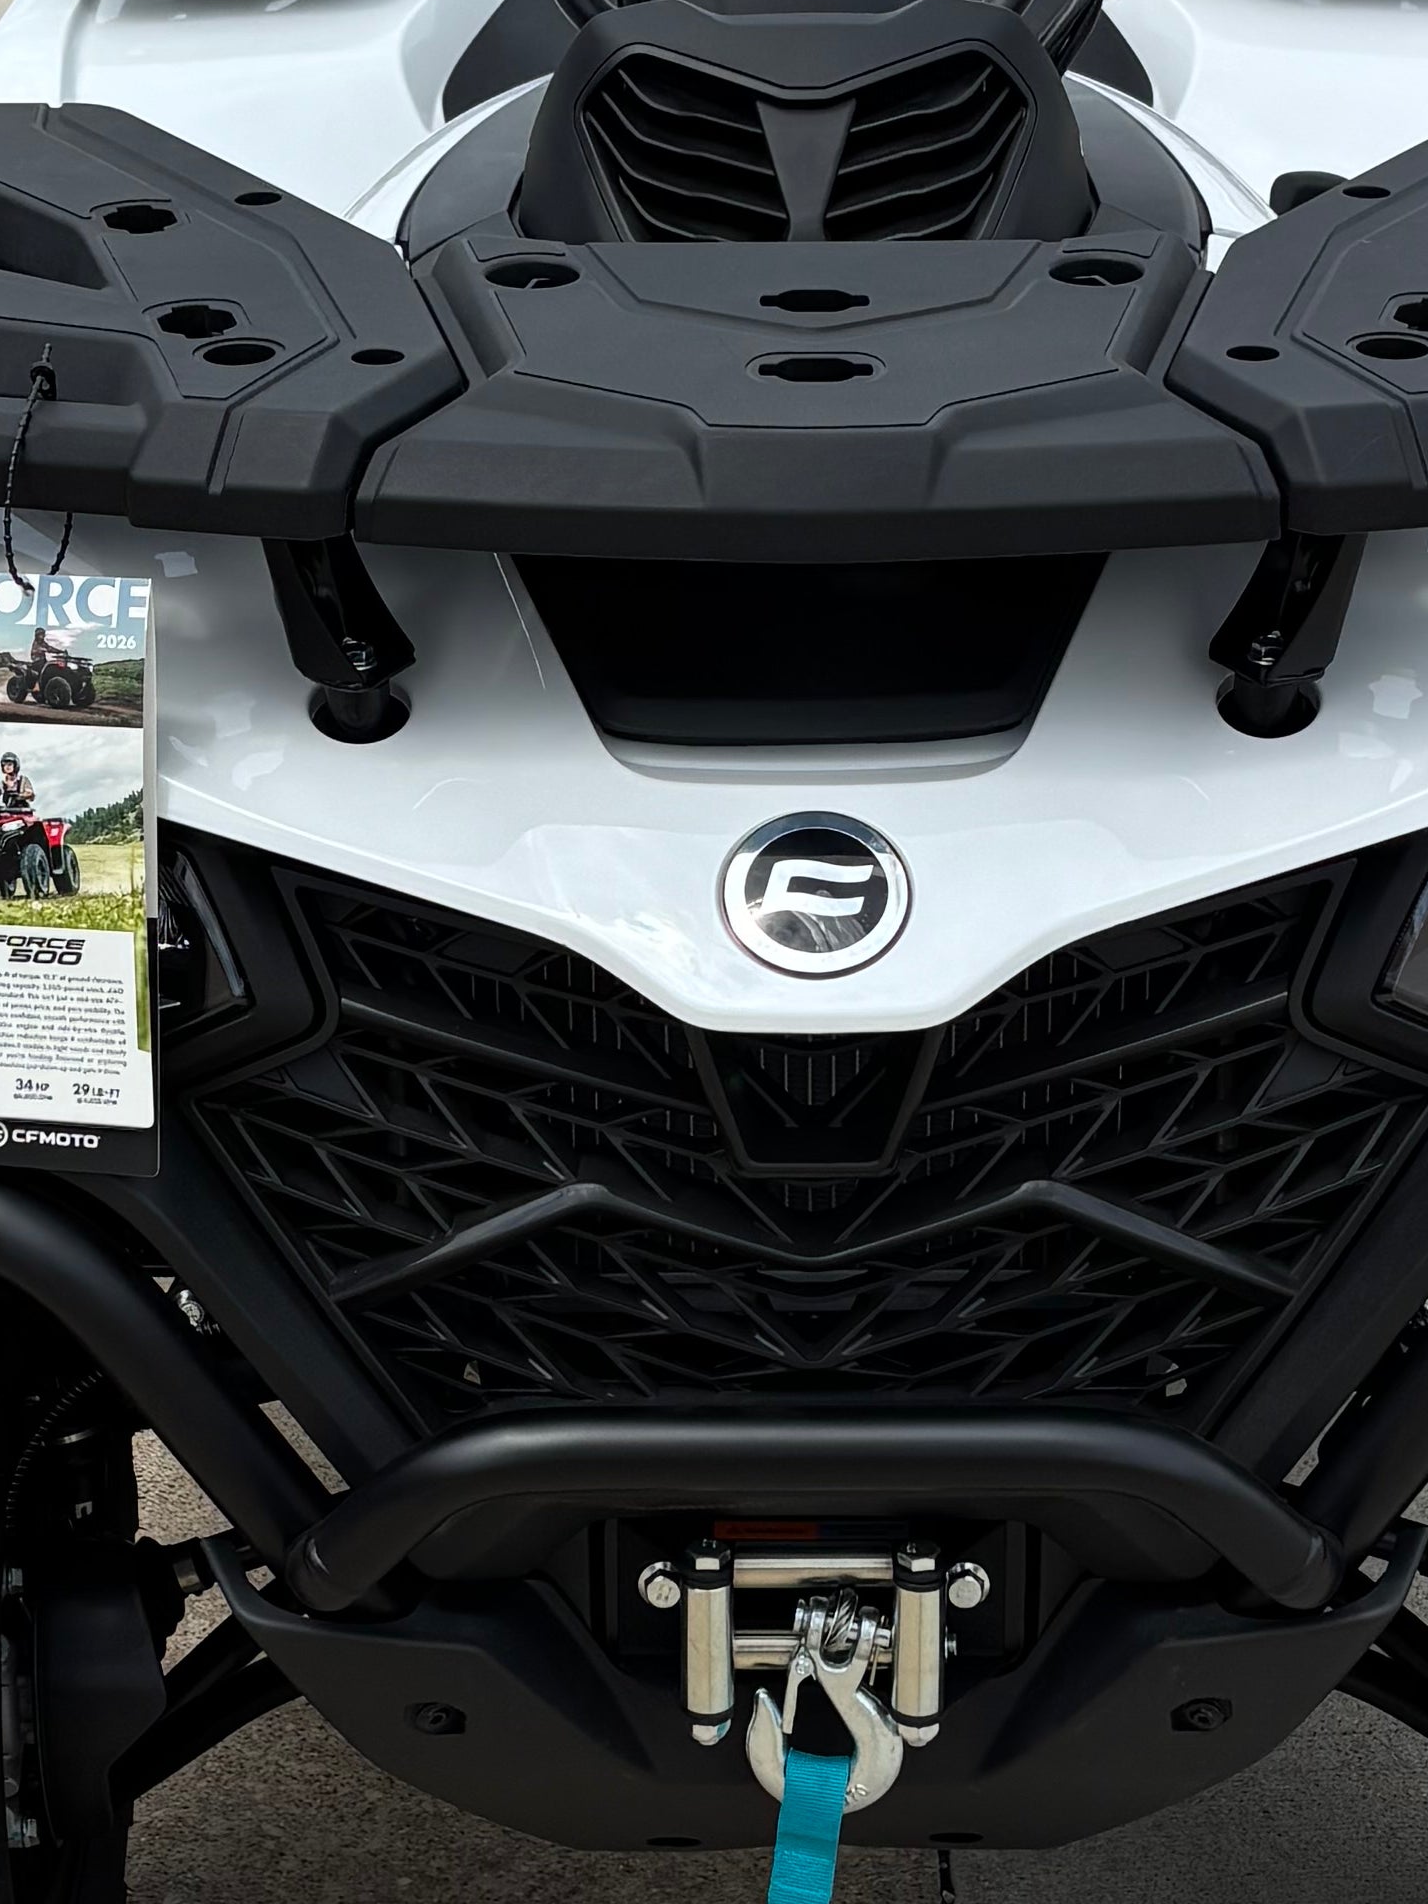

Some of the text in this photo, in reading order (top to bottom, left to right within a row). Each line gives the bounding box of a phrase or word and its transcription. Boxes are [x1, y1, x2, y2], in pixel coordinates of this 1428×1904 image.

[97, 634, 137, 649] 2026
[8, 948, 83, 965] 500
[15, 1078, 33, 1091] 34
[72, 1083, 90, 1096] 29
[11, 1128, 99, 1149] CFMOTO
